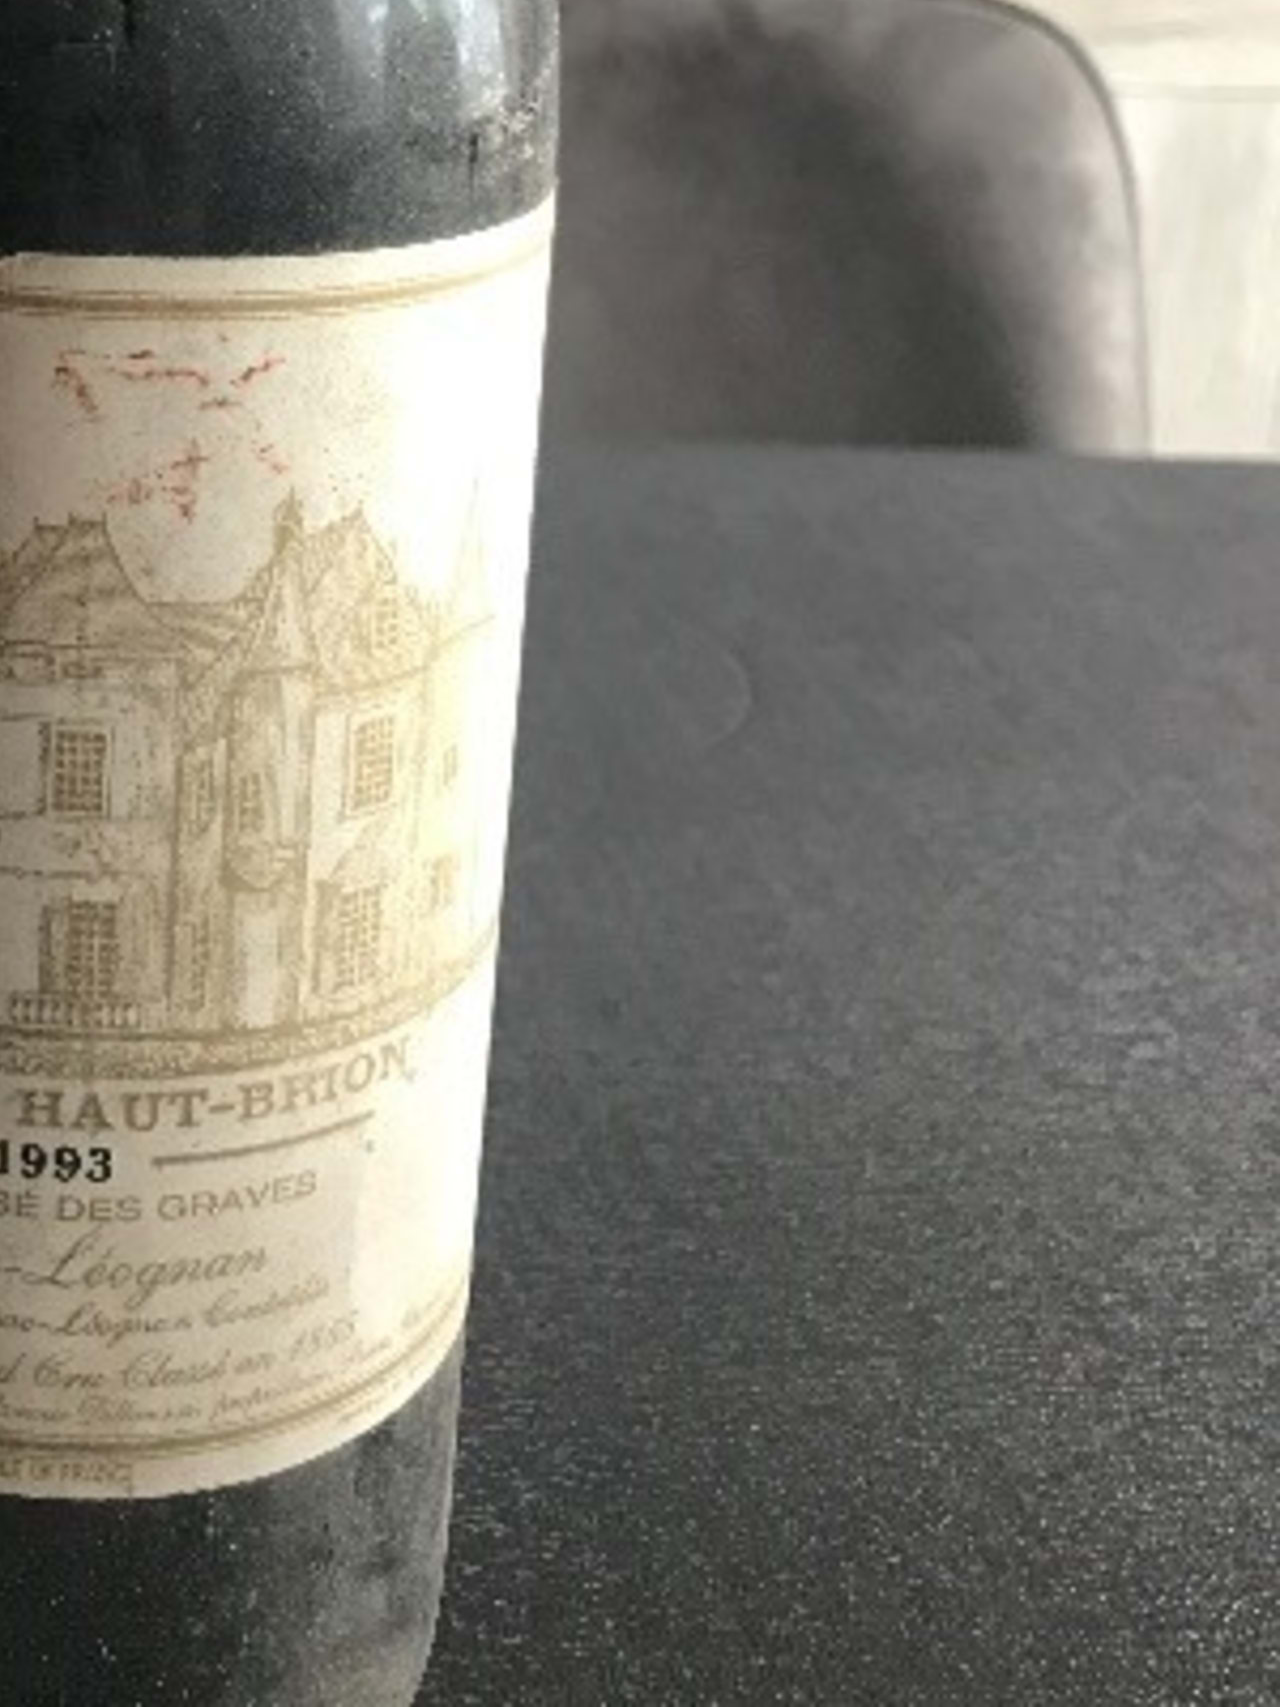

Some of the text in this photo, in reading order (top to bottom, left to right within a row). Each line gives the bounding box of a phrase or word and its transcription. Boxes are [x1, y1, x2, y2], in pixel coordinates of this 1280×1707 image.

[15, 1040, 410, 1133] HAUT-BRION
[58, 1195, 143, 1222] DES
[158, 1170, 318, 1222] GRAVES
